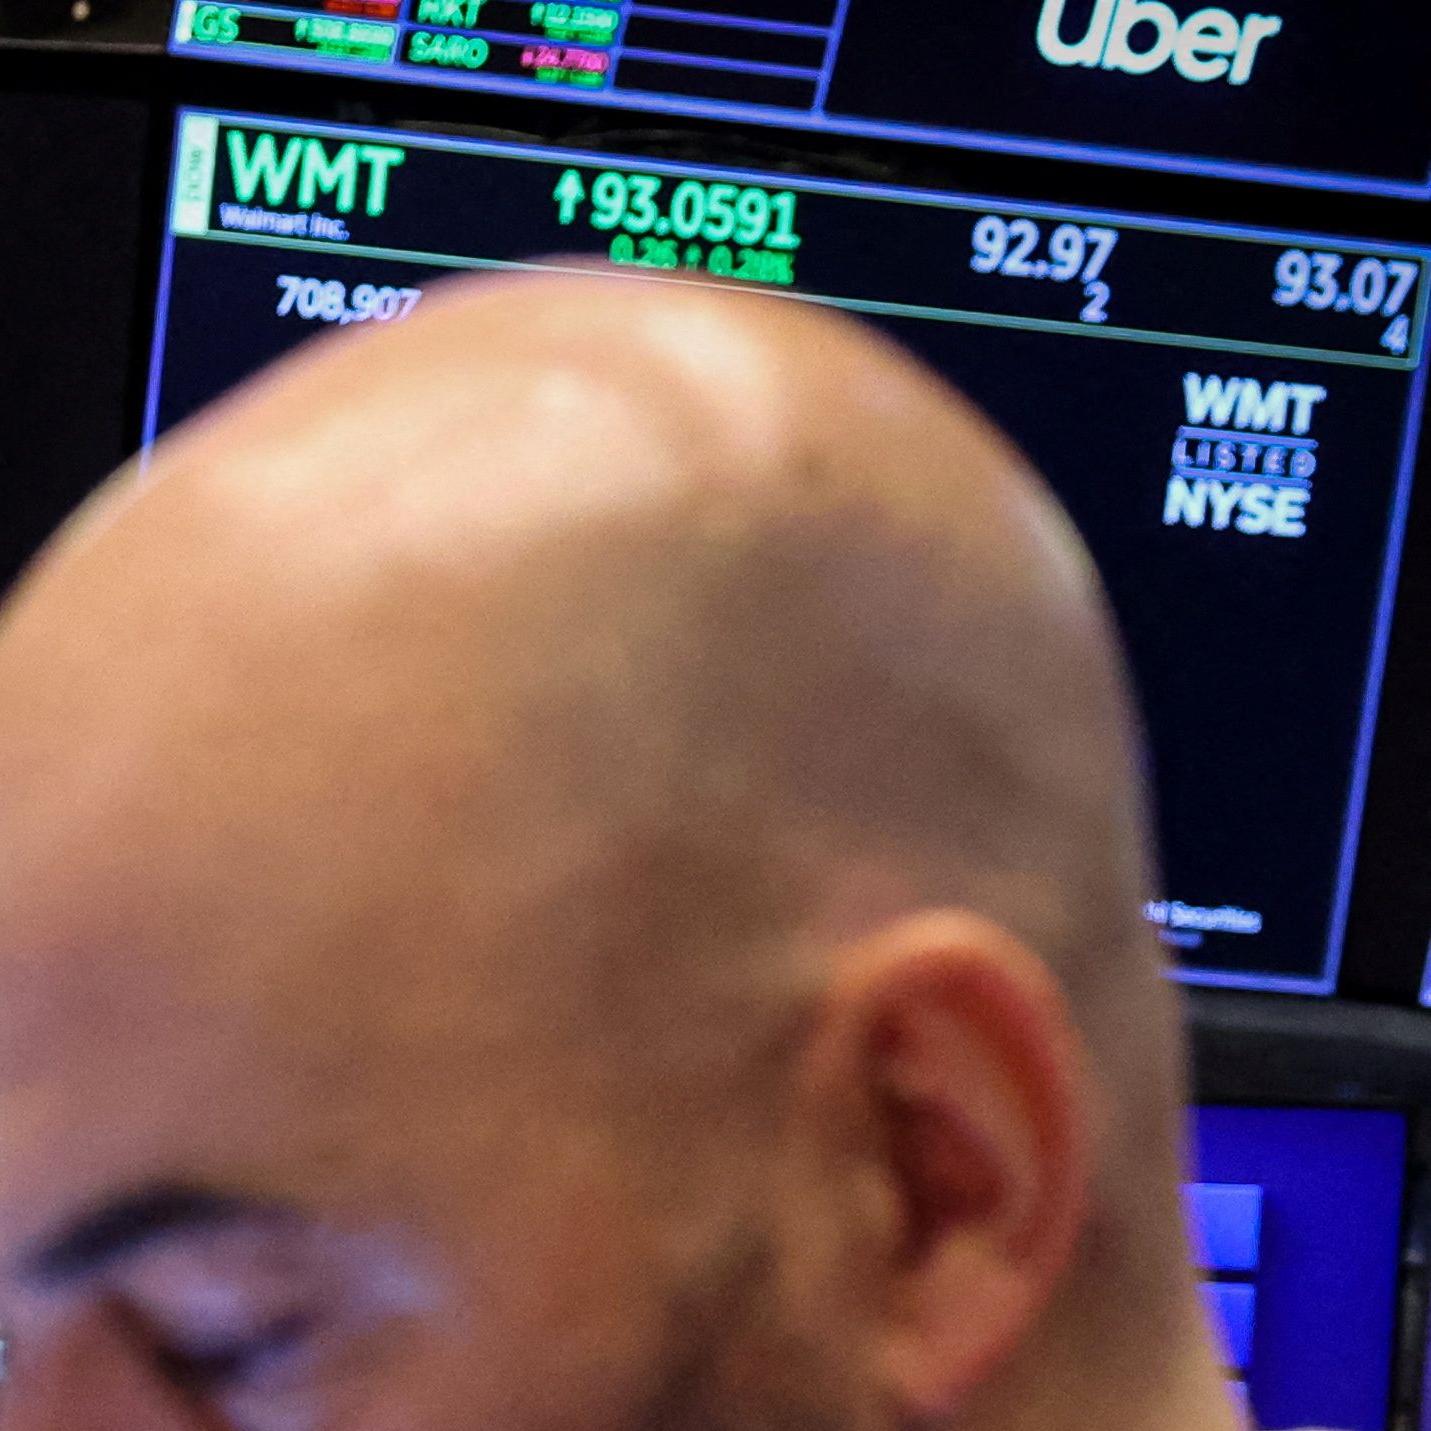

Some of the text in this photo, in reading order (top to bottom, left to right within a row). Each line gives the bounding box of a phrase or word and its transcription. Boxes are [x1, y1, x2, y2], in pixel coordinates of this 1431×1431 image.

[193, 5, 242, 44] GS
[1036, 0, 1282, 85] Uber
[226, 130, 1419, 315] WMT 93.0591 92.97 93.07
[276, 275, 422, 326] 708,907
[1080, 280, 1111, 323] 2
[1382, 315, 1410, 355] 4
[1183, 373, 1327, 434] WMT
[1172, 439, 1317, 478] LISTED
[1163, 477, 1312, 538] NYSE
